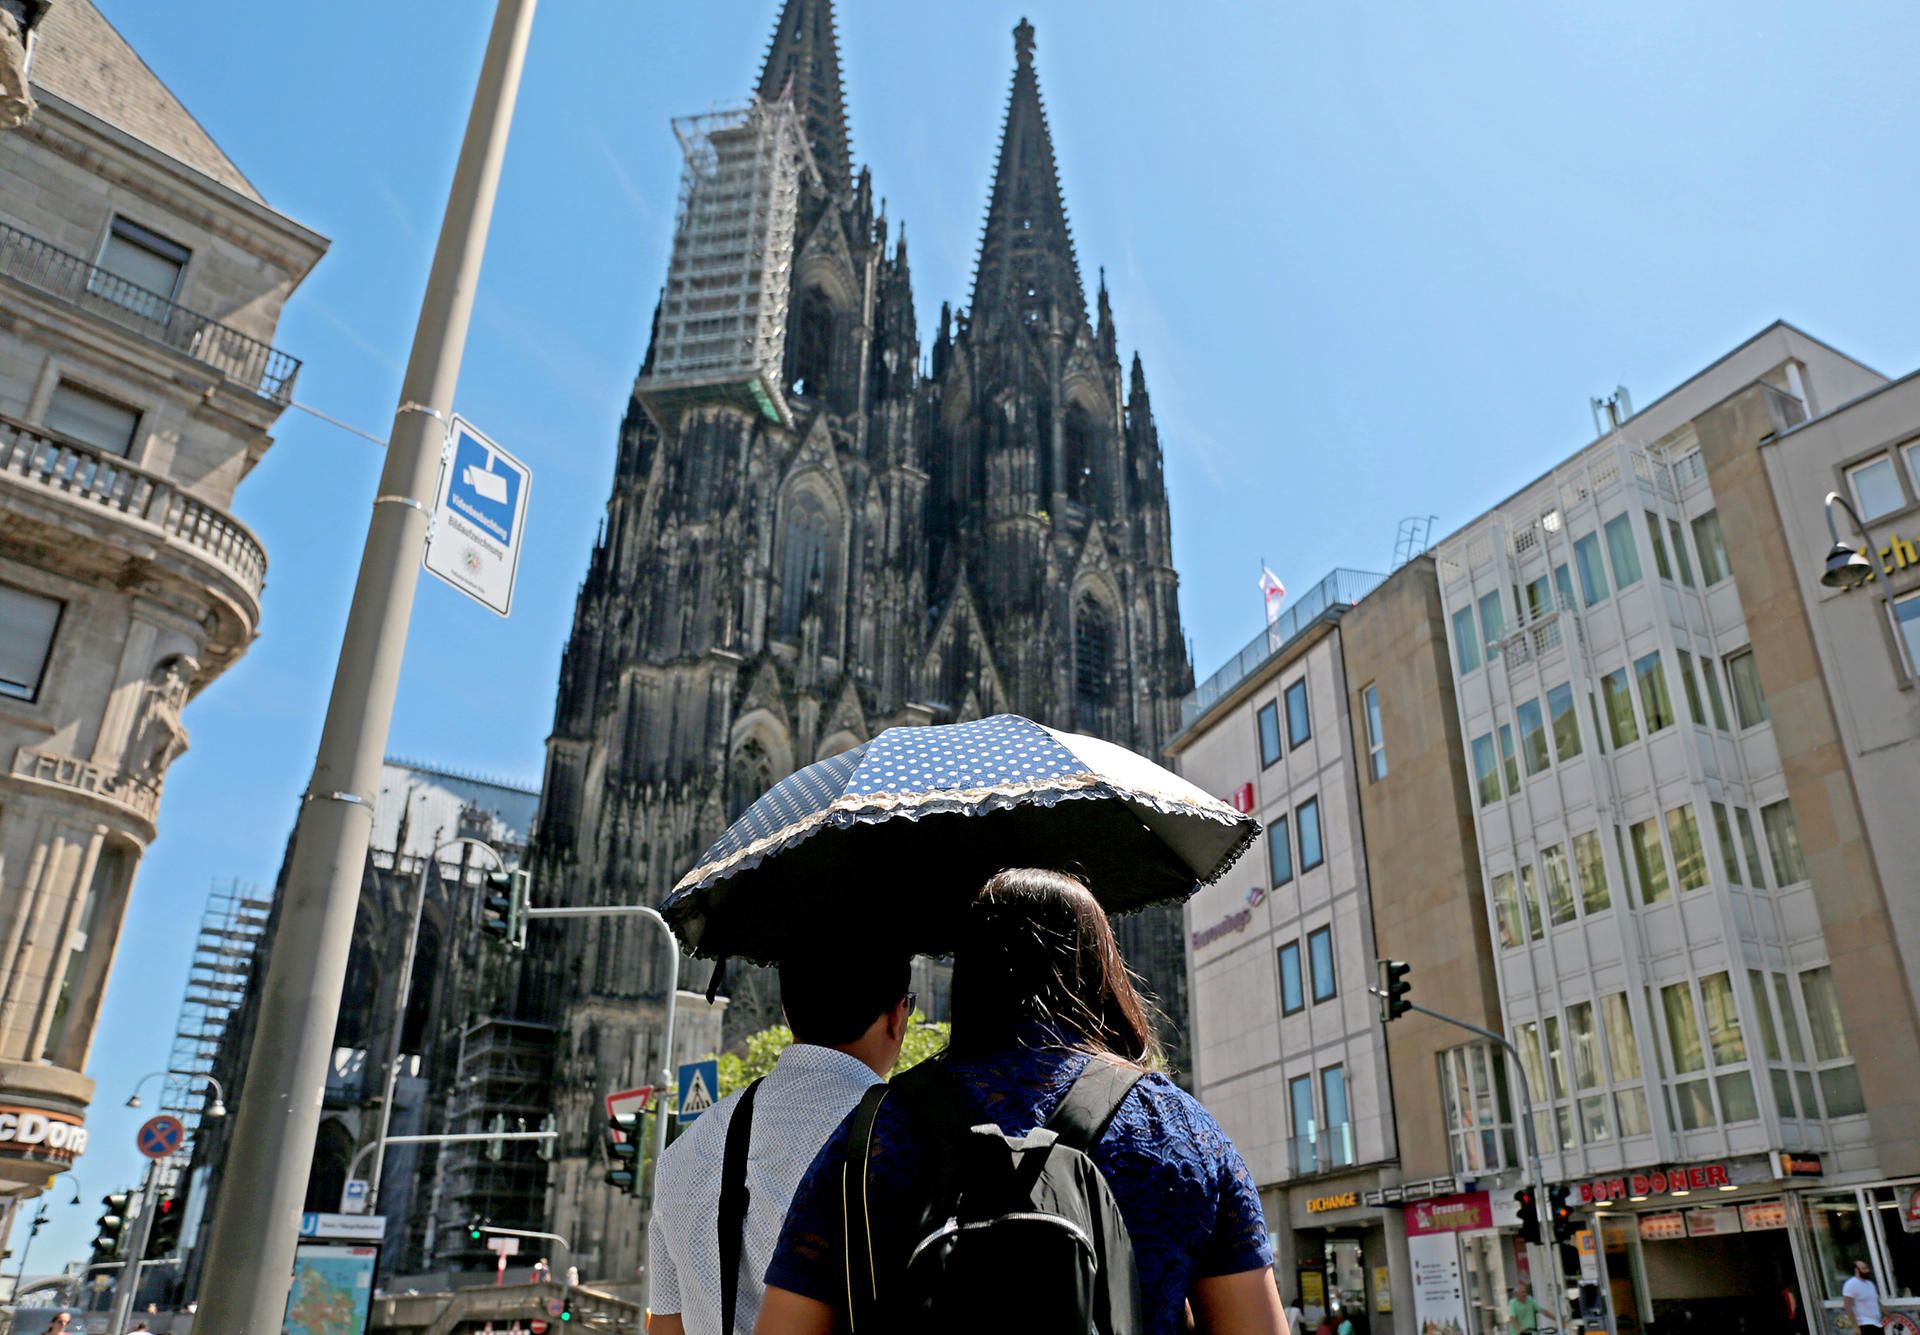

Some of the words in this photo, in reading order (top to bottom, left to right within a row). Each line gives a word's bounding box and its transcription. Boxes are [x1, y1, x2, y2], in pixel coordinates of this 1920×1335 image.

[1579, 1175, 1627, 1203] DOM
[1306, 1191, 1358, 1214] EXCHANGE
[1431, 1202, 1464, 1216] frozen
